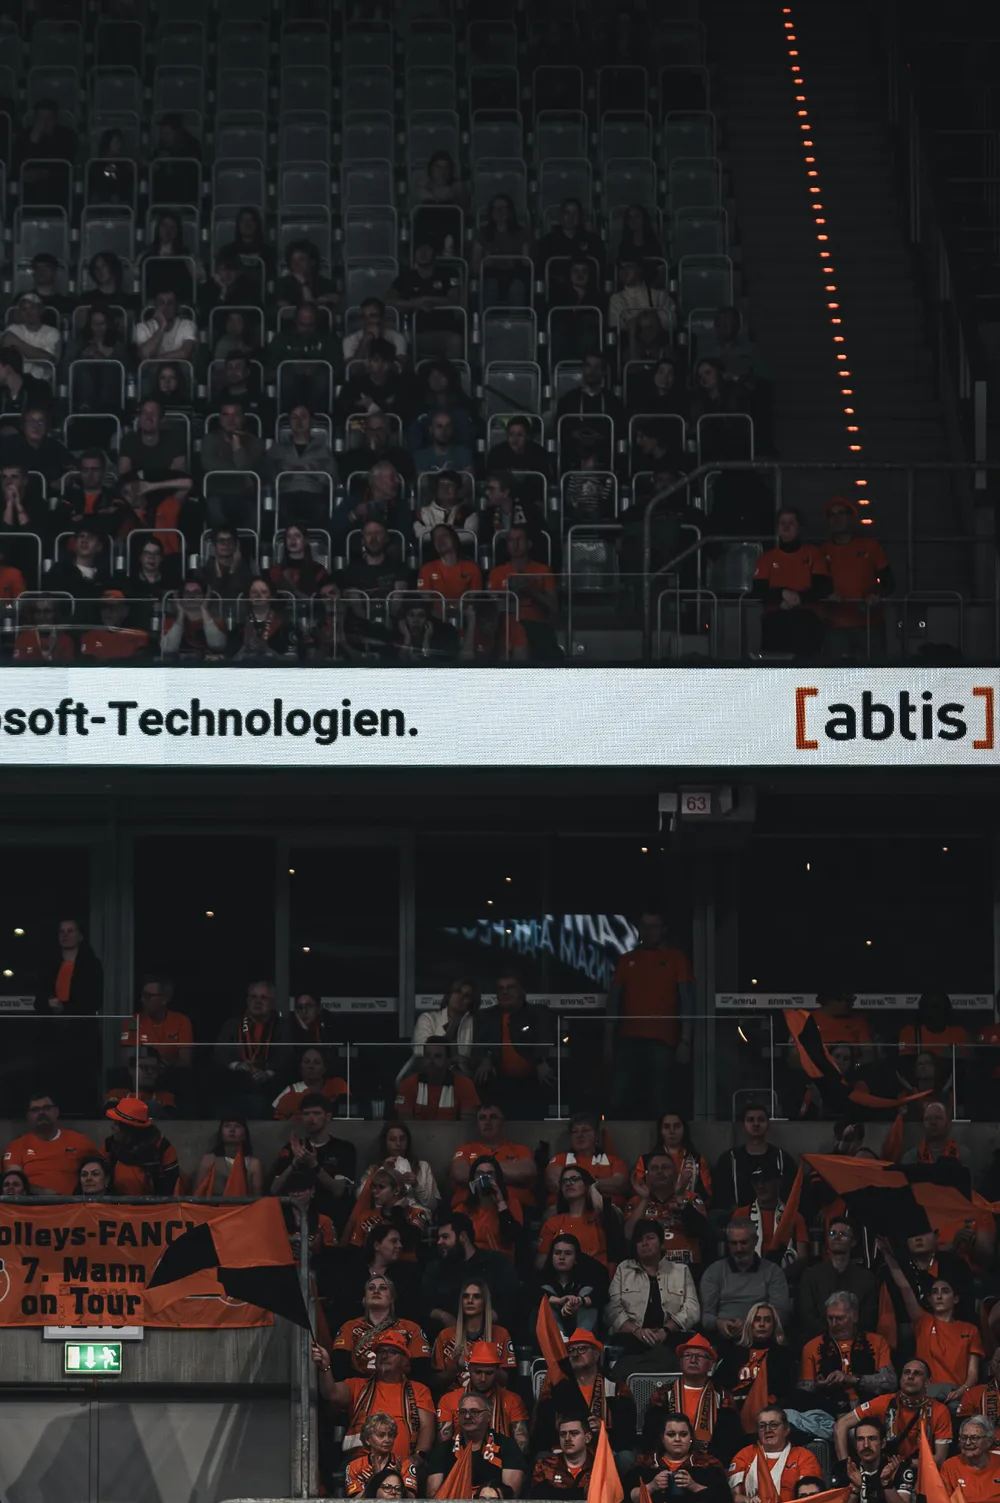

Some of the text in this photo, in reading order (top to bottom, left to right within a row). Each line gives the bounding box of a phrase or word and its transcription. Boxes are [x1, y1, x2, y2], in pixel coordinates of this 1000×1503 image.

[686, 796, 707, 811] 63
[22, 1257, 146, 1283] 7. Mann
[22, 1295, 57, 1315] on
[70, 1288, 141, 1315] Tour
